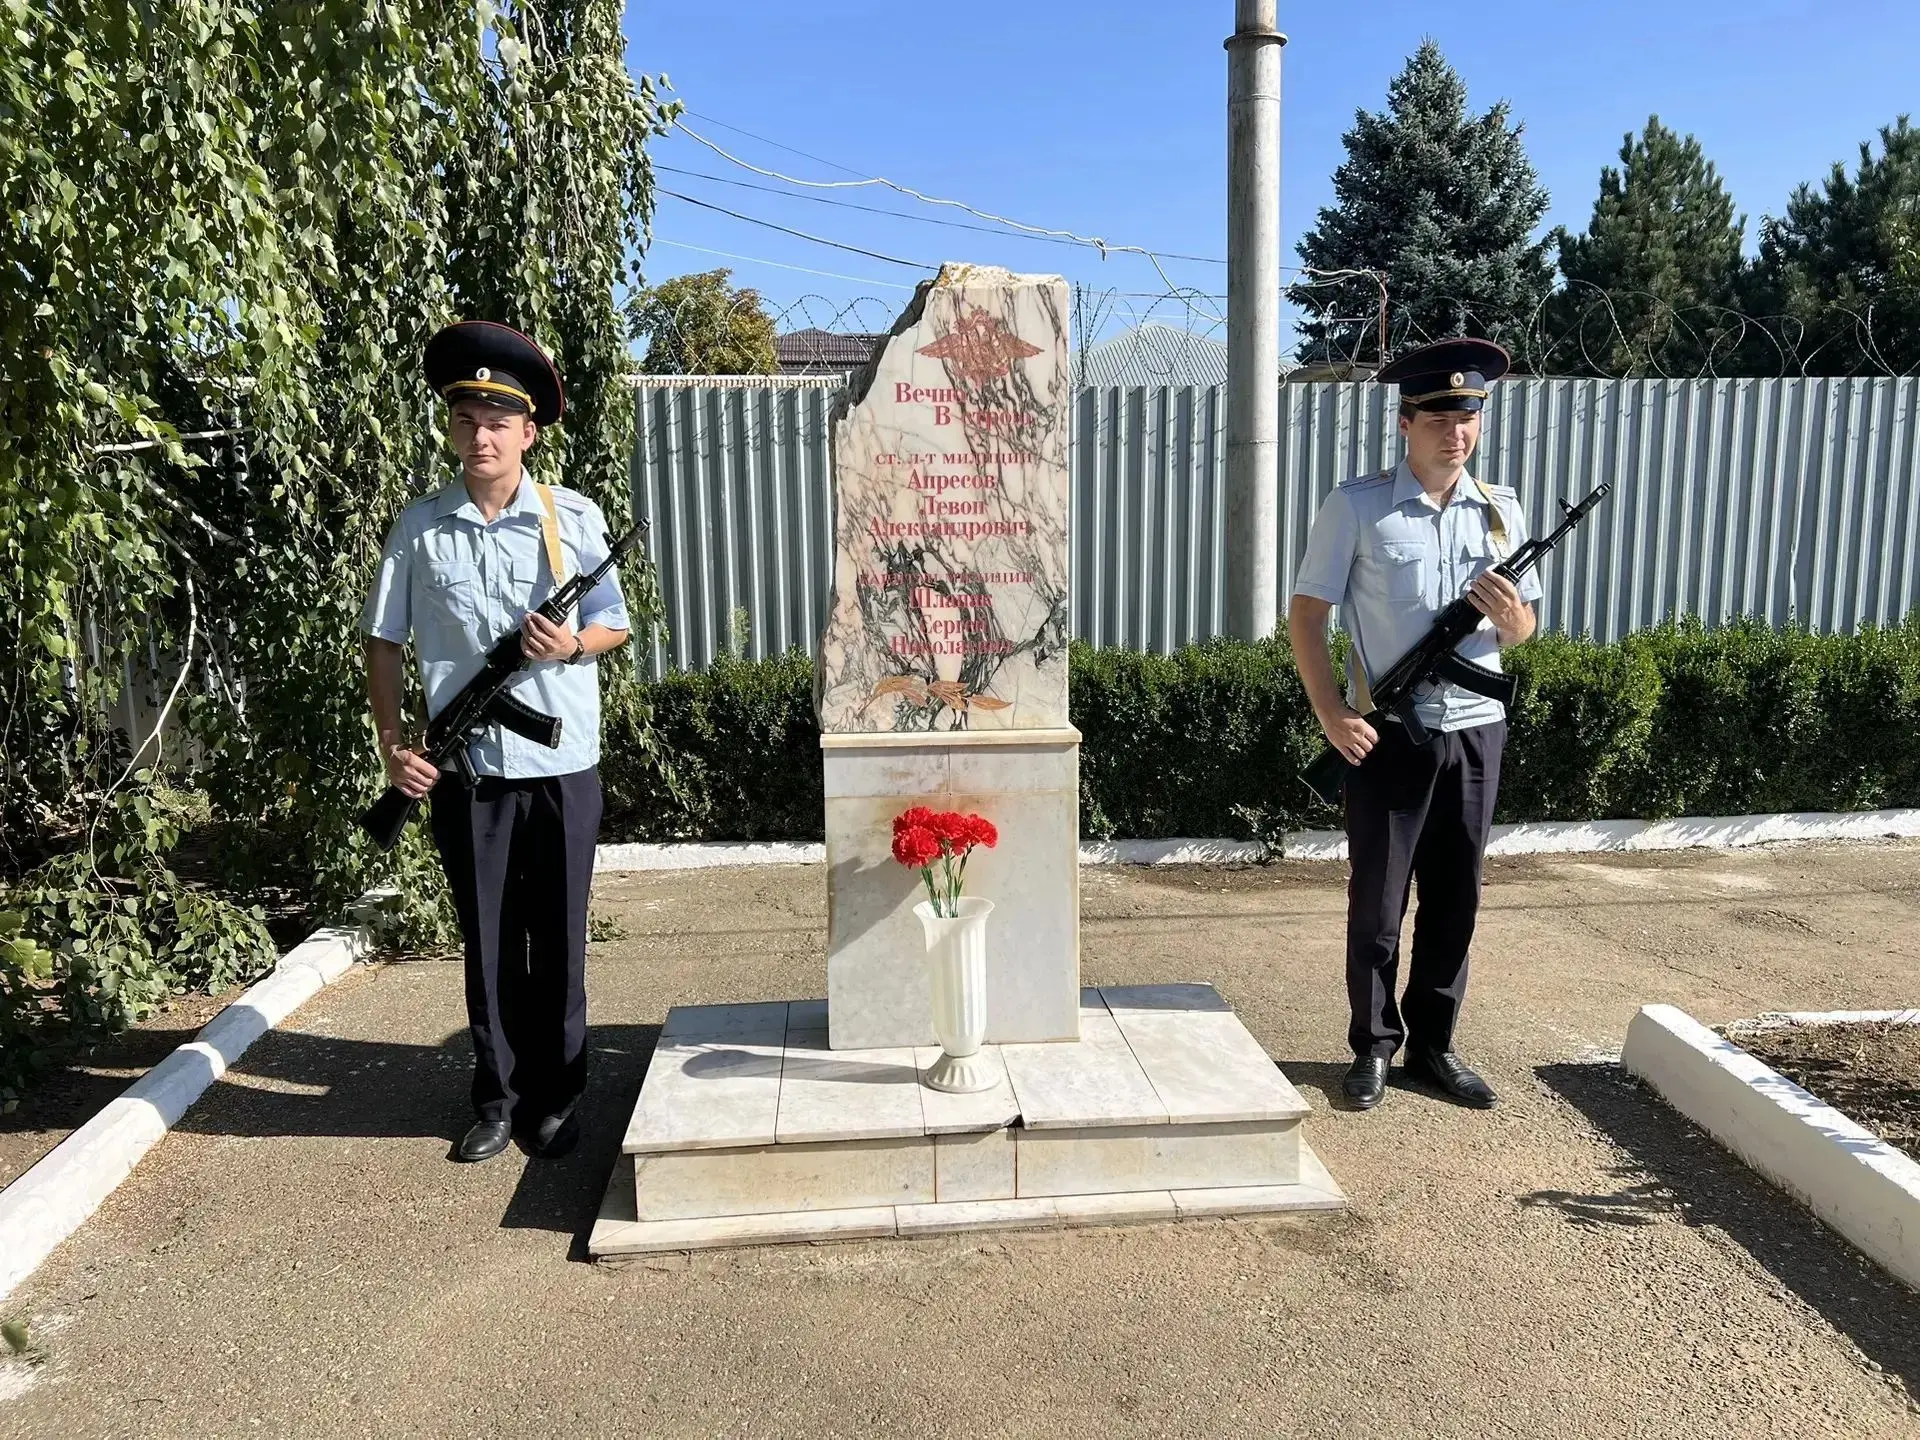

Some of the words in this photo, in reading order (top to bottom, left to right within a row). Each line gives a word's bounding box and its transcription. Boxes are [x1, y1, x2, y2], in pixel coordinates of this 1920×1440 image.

[894, 382, 968, 403] Вечно
[934, 405, 951, 426] В
[908, 469, 996, 494] Апресов
[868, 516, 1031, 540] Александрович
